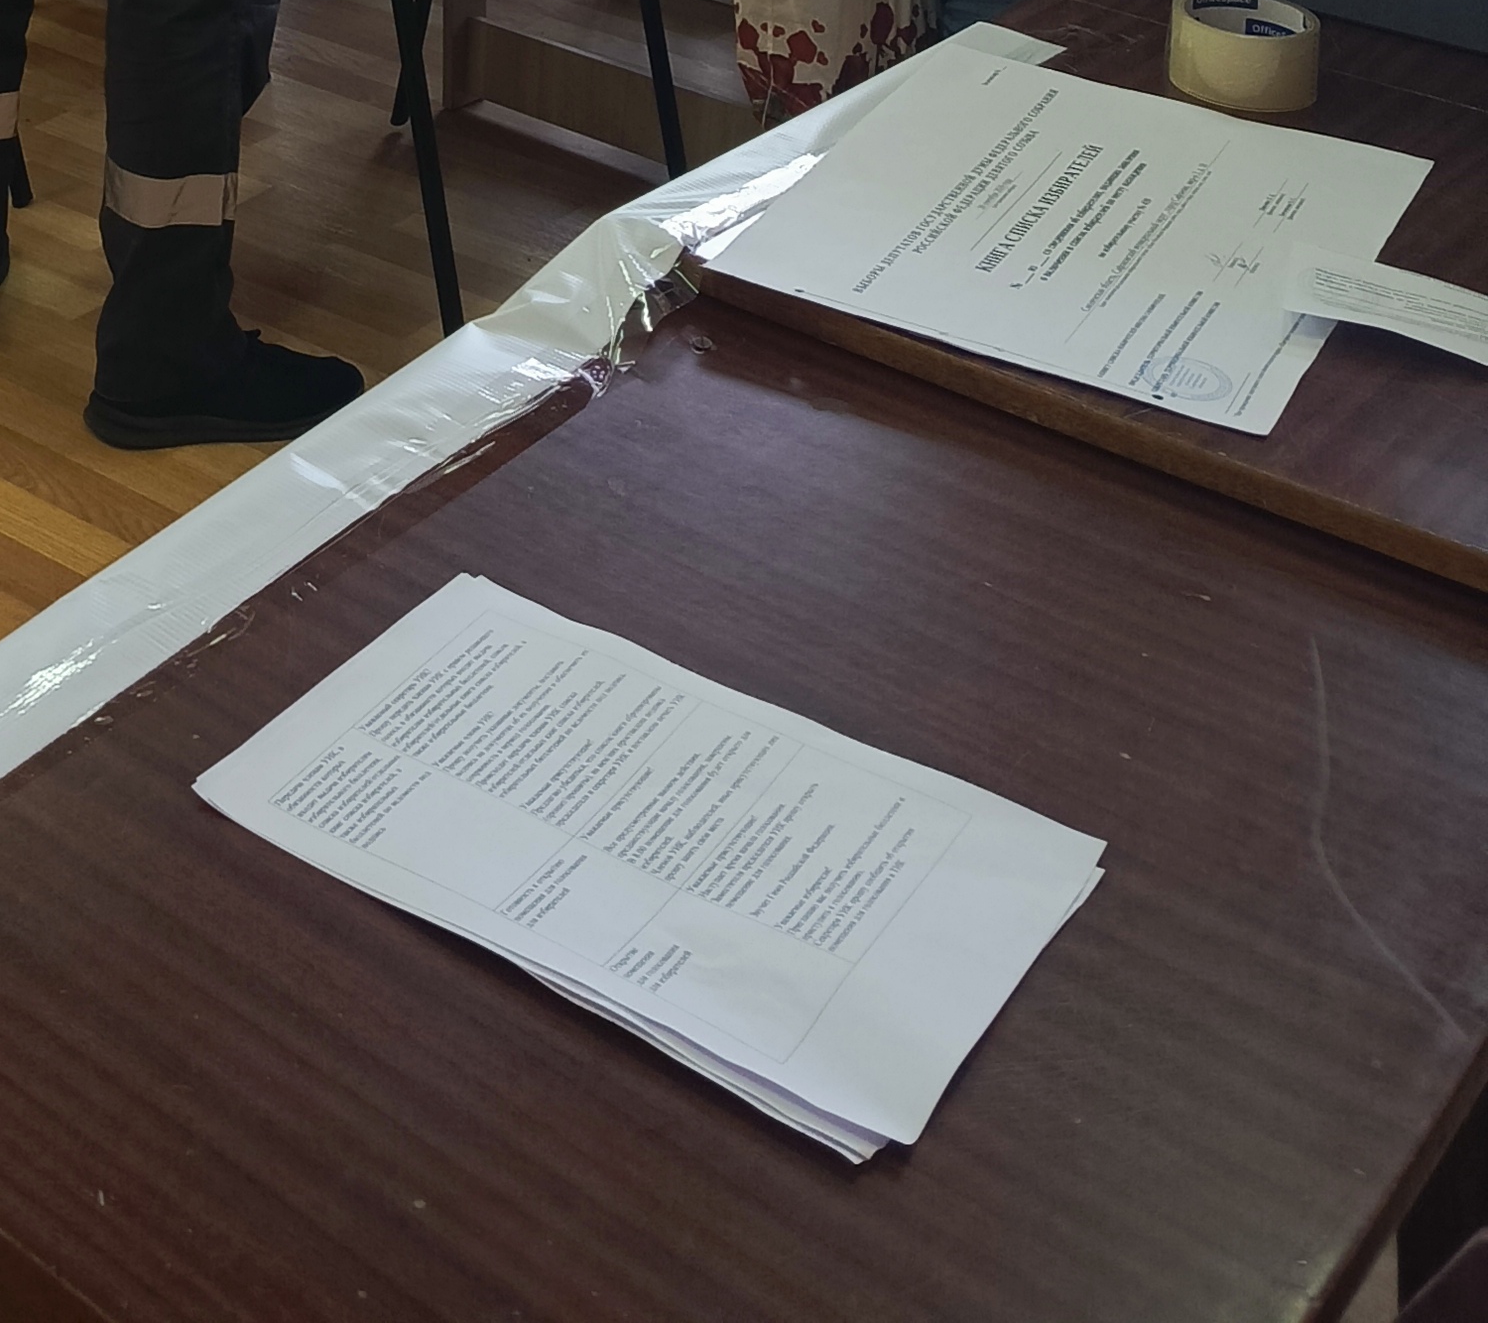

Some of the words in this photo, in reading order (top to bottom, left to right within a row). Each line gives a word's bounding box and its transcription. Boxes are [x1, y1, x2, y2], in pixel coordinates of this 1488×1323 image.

[975, 243, 1014, 272] КНИГА
[1004, 206, 1048, 241] СПИСКА
[1038, 145, 1102, 204] ИЗБИРАТЕЛЕЙ
